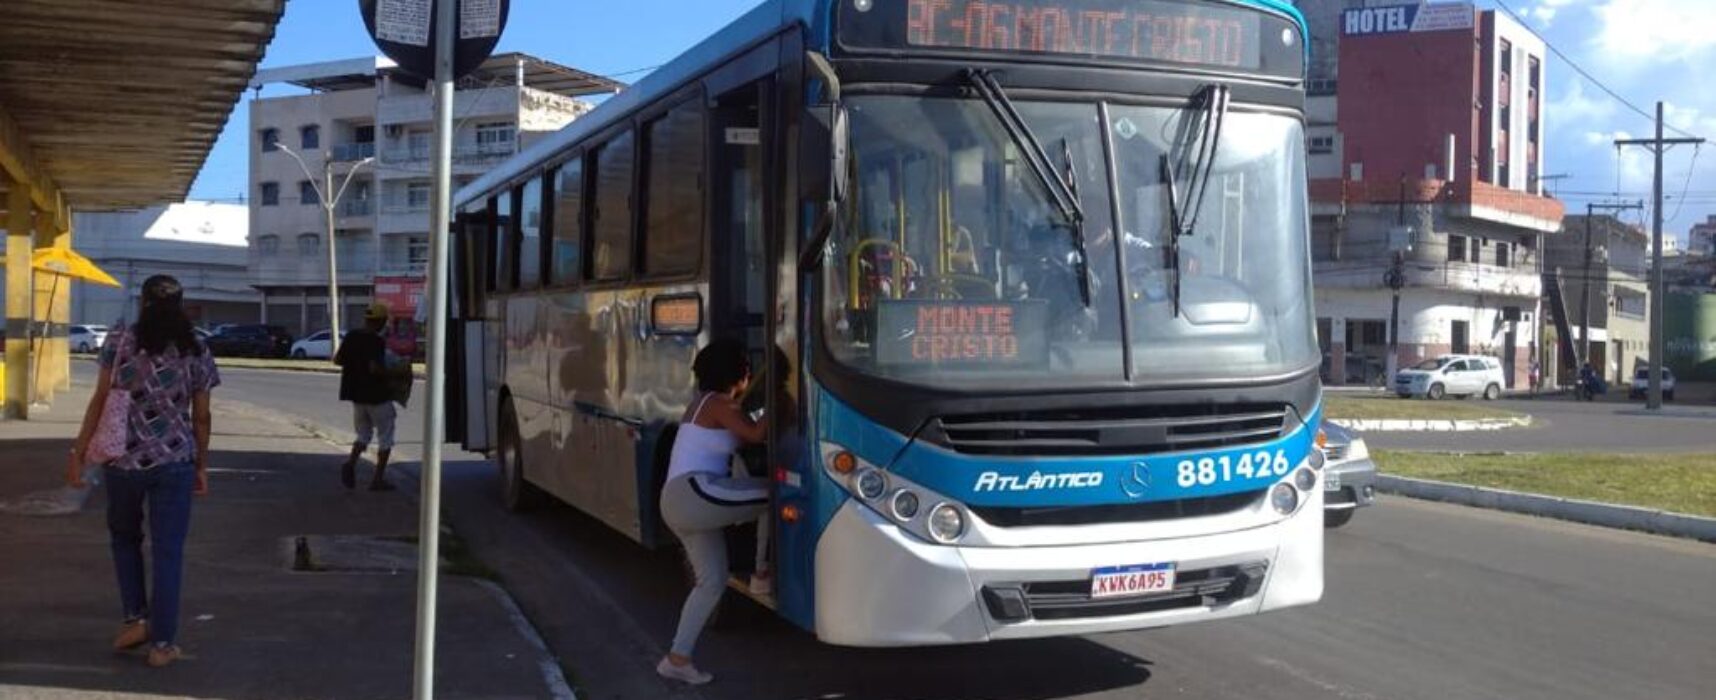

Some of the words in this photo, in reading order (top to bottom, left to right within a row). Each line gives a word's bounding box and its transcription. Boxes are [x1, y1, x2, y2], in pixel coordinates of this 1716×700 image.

[1345, 7, 1408, 33] HOTEL
[1015, 5, 1125, 54] MONTE
[1132, 12, 1242, 65] CRISTO
[917, 305, 1013, 333] MONTE
[912, 334, 1017, 361] CRISTO
[1177, 450, 1289, 487] 881426
[1098, 572, 1166, 593] KWK6A95
